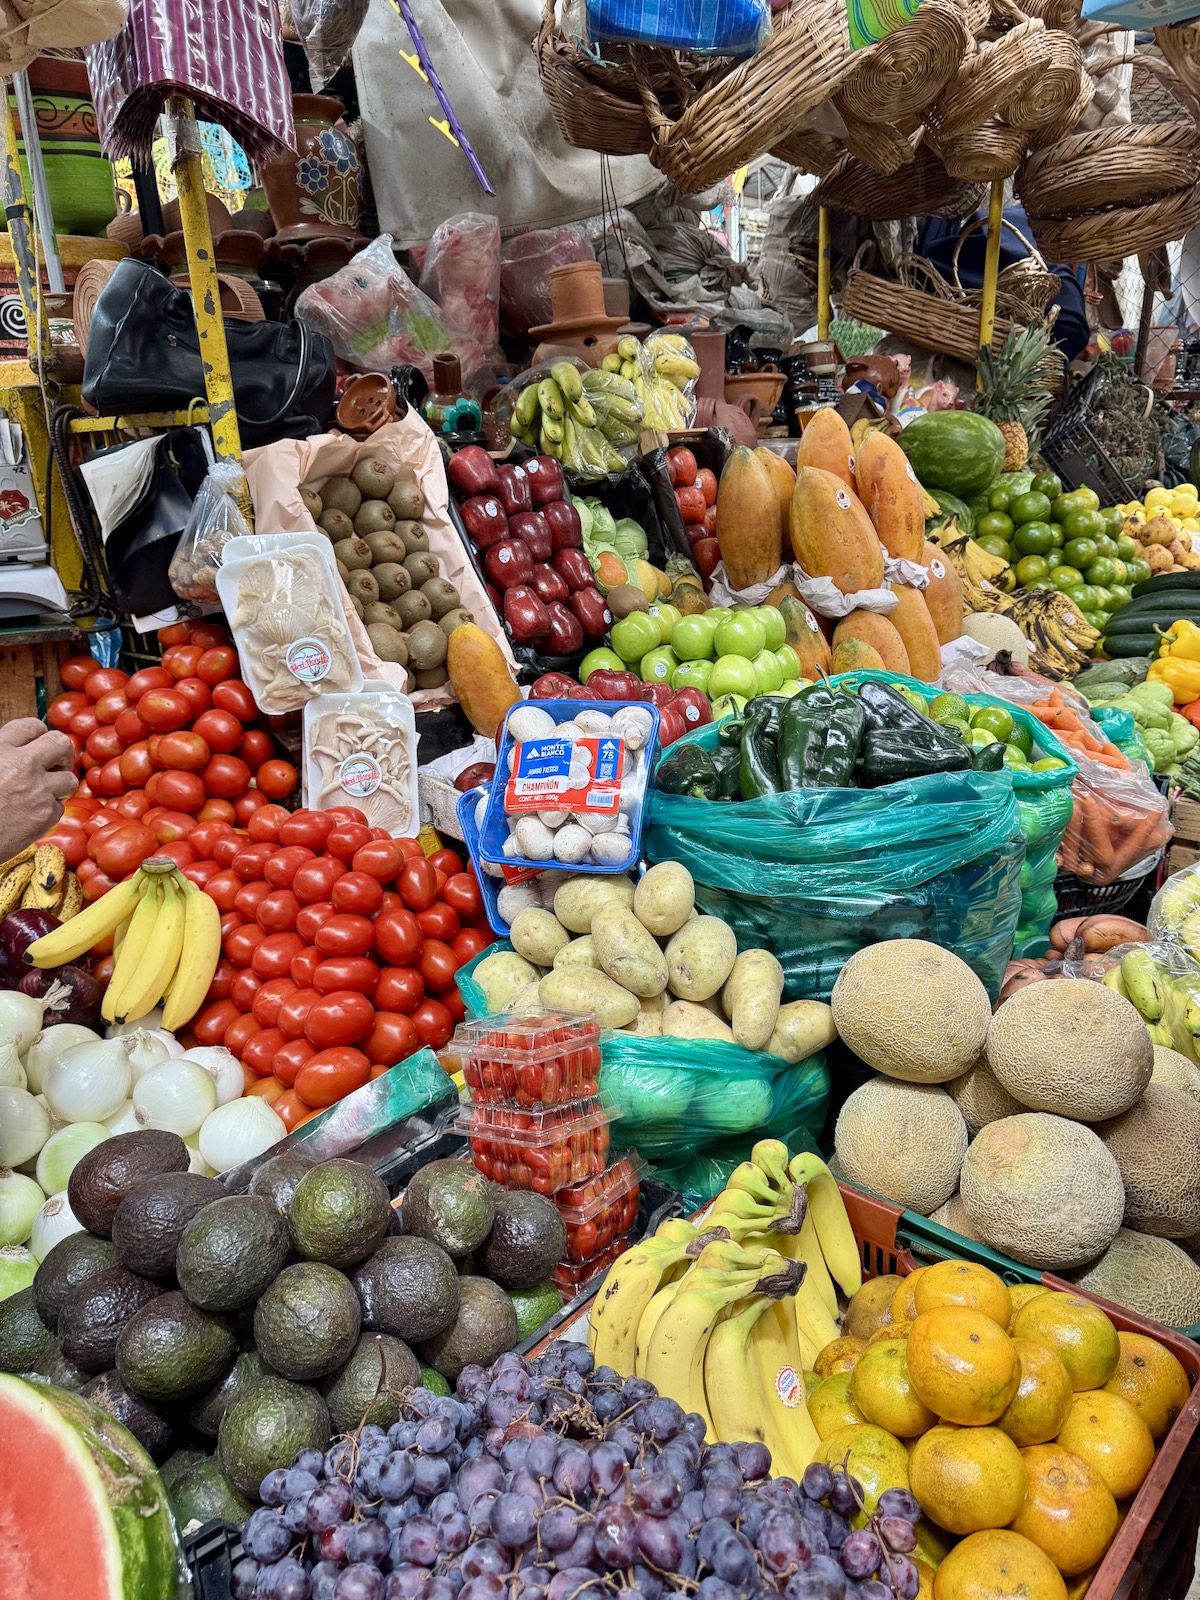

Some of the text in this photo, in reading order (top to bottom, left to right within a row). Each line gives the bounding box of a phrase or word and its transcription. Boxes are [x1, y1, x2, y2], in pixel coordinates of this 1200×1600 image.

[541, 743, 565, 752] MONTE
[540, 749, 565, 758] BLANCO
[602, 750, 615, 760] 75
[528, 765, 559, 775] JUMBO FRESCO
[522, 779, 559, 792] CHAMPIÑÓN
[545, 794, 560, 802] 500g
